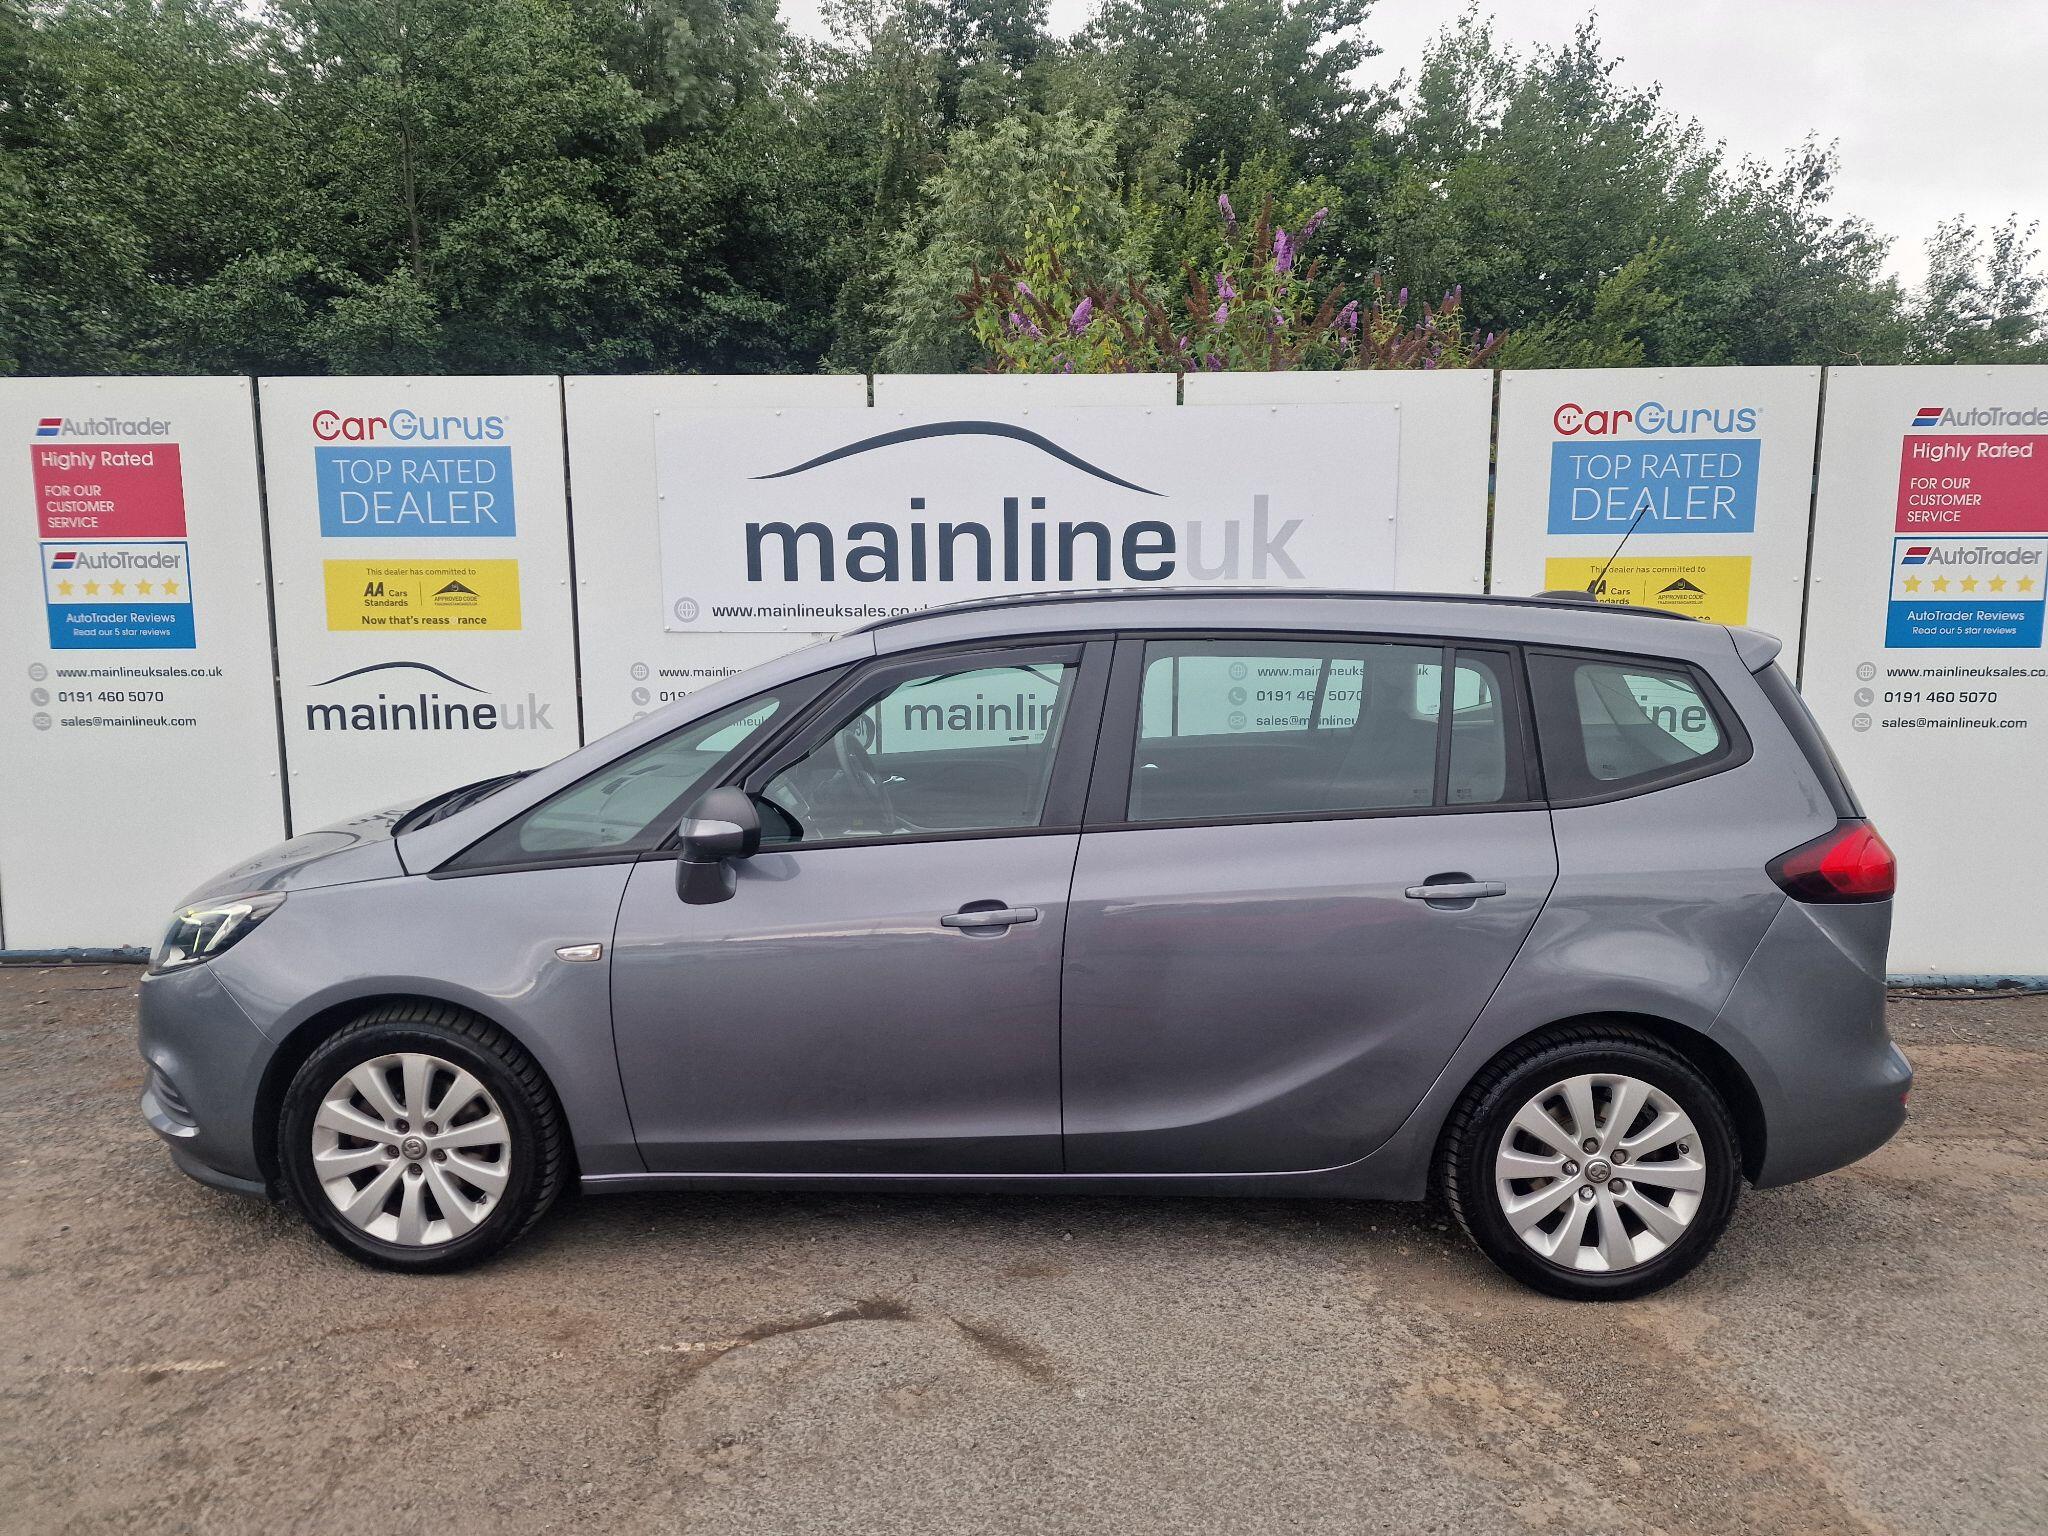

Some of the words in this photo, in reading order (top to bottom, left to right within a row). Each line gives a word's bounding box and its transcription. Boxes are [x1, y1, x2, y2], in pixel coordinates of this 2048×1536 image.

[312, 408, 504, 441] CarGurus
[1553, 402, 1757, 436] CarGurus
[62, 416, 171, 437] AutoTrader
[1912, 442, 1972, 462] Highly
[1976, 441, 2033, 459] Rated
[41, 450, 96, 470] Highly
[101, 450, 154, 467] Rated
[1568, 453, 1632, 481] TOP
[1641, 452, 1743, 480] RATED
[331, 459, 392, 484] TOP
[401, 459, 497, 484] RATED
[1910, 477, 1938, 490] FOR
[1941, 477, 1971, 490] OUR
[44, 484, 71, 497] FOR
[73, 484, 102, 497] OUR
[46, 500, 115, 513] CUSTOMER
[1570, 485, 1738, 522] DEALER
[1908, 493, 1982, 507] CUSTOMER
[339, 490, 499, 525] DEALER
[47, 516, 99, 529] SERVICE
[1906, 510, 1961, 523] SERVICE
[744, 495, 1307, 582] mainlineuk
[75, 550, 181, 570] AutoTrader
[1927, 546, 2042, 566] AutoTrader
[366, 567, 382, 576] This
[384, 567, 408, 576] dealer
[409, 567, 424, 576] has
[425, 567, 467, 576] committed
[468, 567, 477, 576] to
[1608, 565, 1633, 574] dealer
[1635, 565, 1651, 574] has
[1652, 565, 1696, 574] committed
[1697, 565, 1706, 574] to
[363, 581, 384, 597] AA
[388, 589, 408, 597] Cars
[1610, 587, 1631, 595] Cars
[364, 599, 408, 607] Standards
[66, 612, 128, 624] AutoTrader
[130, 612, 176, 624] Reviews
[361, 615, 386, 626] Now
[421, 615, 488, 626] reassrance
[1907, 611, 1974, 622] AutoTrader
[1976, 610, 2025, 621] Reviews
[73, 628, 97, 637] Read
[98, 629, 114, 637] our
[115, 628, 120, 637] 5
[122, 628, 138, 637] star
[139, 628, 171, 637] reviews
[1912, 626, 1937, 635] Read
[1938, 627, 1956, 635] our
[1957, 626, 1962, 635] 5
[1964, 626, 1981, 635] star
[1982, 626, 2017, 635] reviews
[56, 667, 223, 678] www.mainlineuksales.co.uk
[58, 691, 93, 702] 0191
[98, 691, 125, 702] 460
[128, 691, 164, 702] 5070
[1256, 690, 1292, 701] 0191
[1884, 691, 1921, 703] 0191
[1925, 691, 1955, 703] 460
[1958, 691, 1998, 703] 5070
[306, 692, 554, 731] mainlineuk
[60, 716, 197, 728] sales@mainlineuk.com
[1881, 716, 2027, 729] sales@mainlineuk.com
